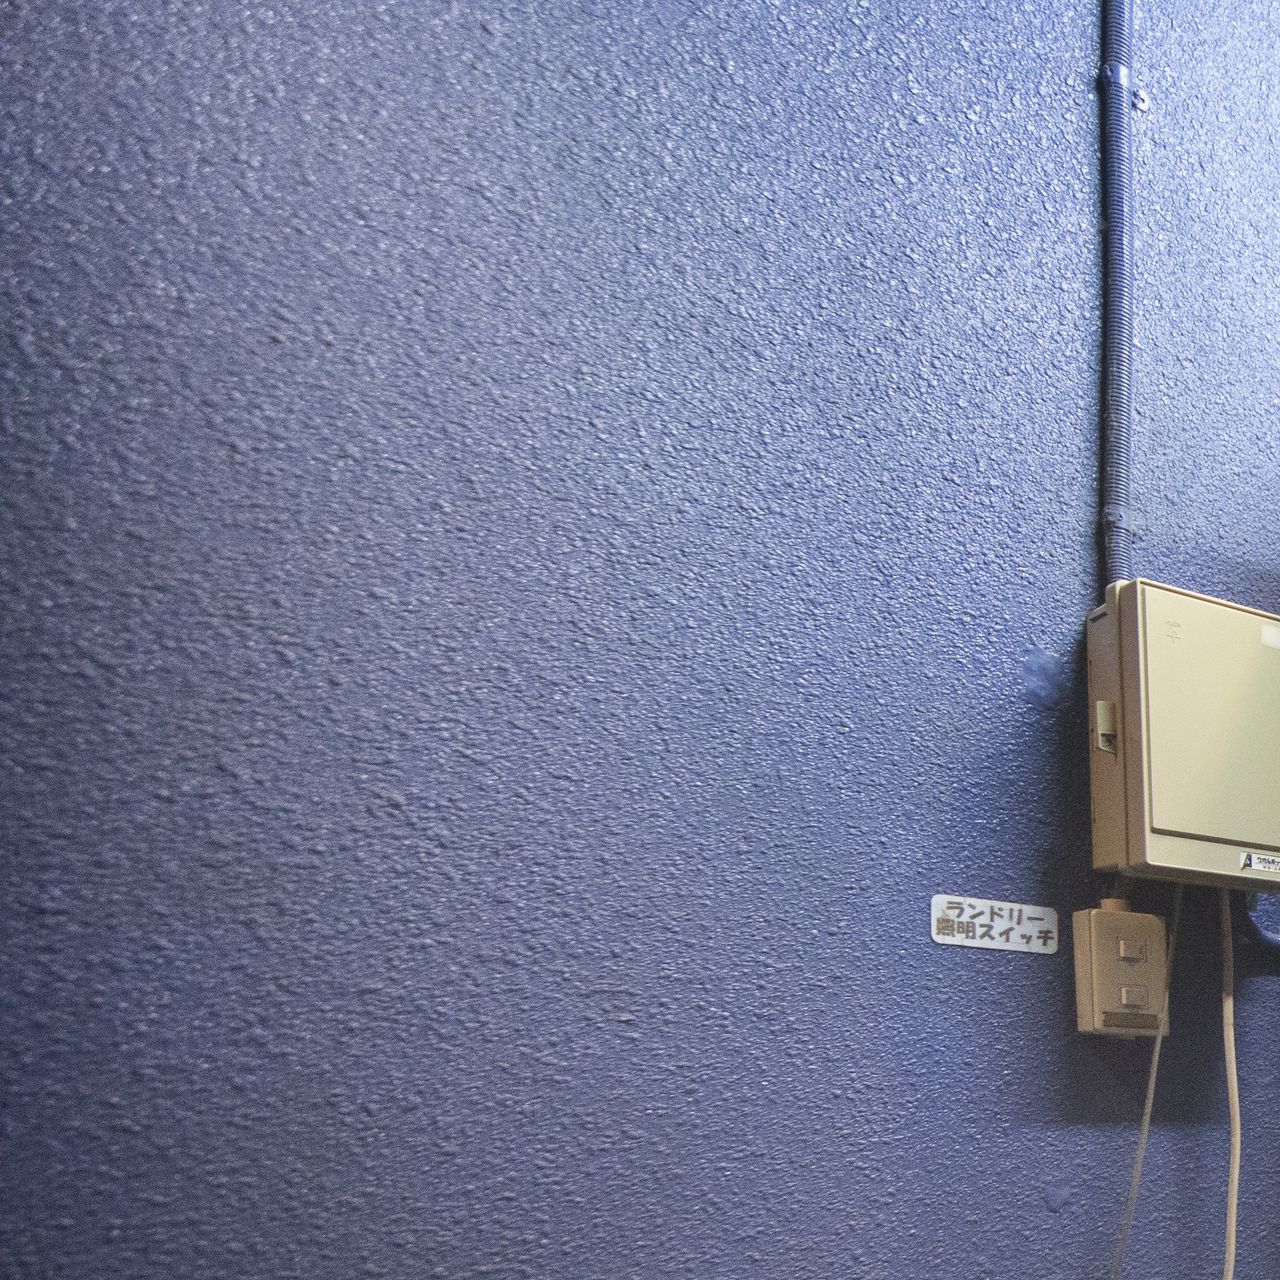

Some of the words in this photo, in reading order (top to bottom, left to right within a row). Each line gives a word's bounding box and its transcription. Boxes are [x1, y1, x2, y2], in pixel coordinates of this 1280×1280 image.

[946, 900, 1045, 926] ランドリー
[936, 917, 1055, 947] 照明スイッチ
